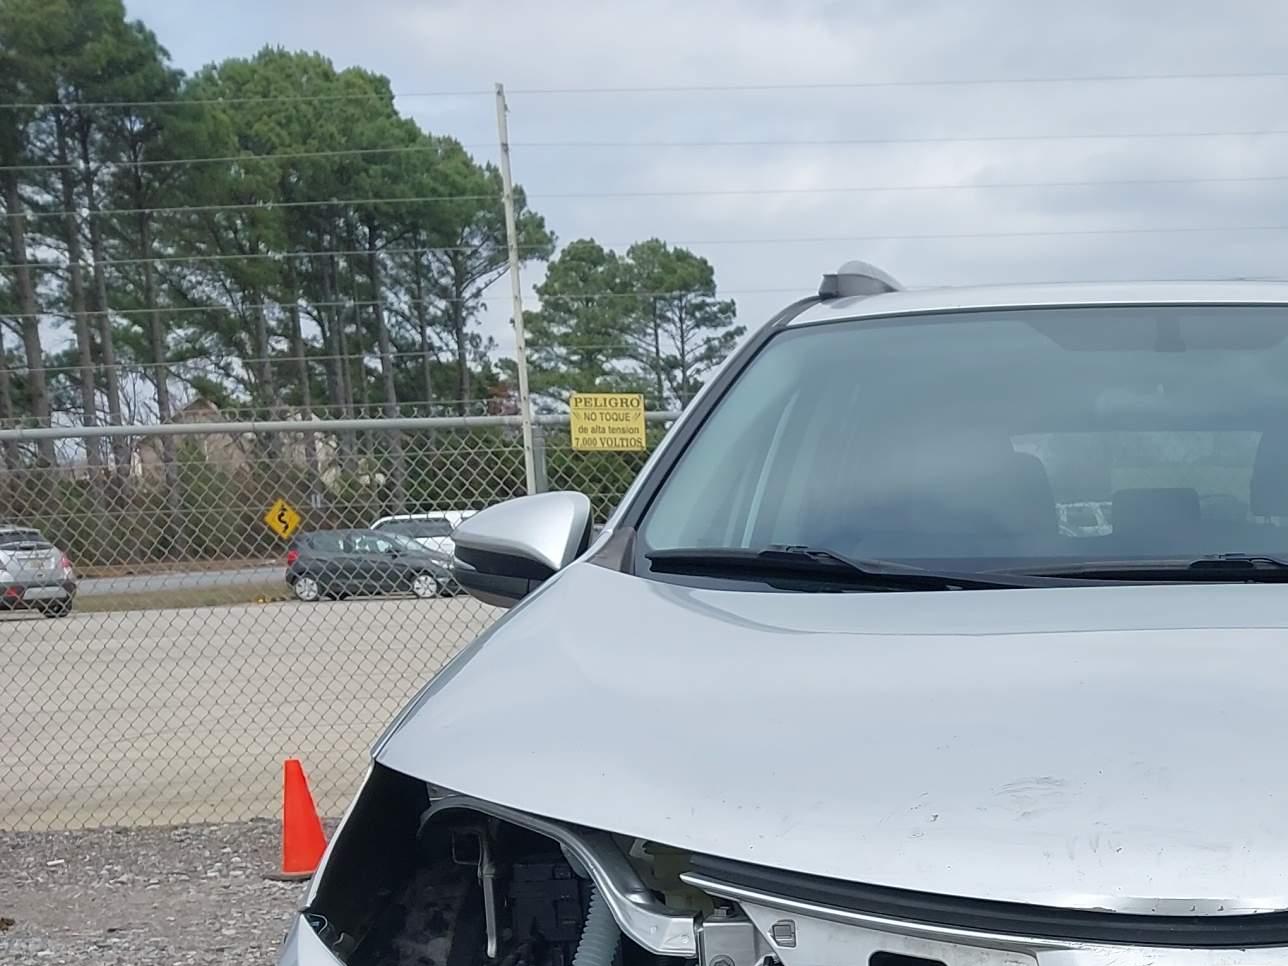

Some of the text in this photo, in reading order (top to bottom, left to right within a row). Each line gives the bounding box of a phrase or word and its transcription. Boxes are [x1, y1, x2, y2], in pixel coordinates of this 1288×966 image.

[574, 397, 641, 408] PELIGRO
[583, 412, 631, 422] NO TOQUE
[578, 424, 640, 434] de alta tension
[599, 438, 643, 448] VOLTIOS
